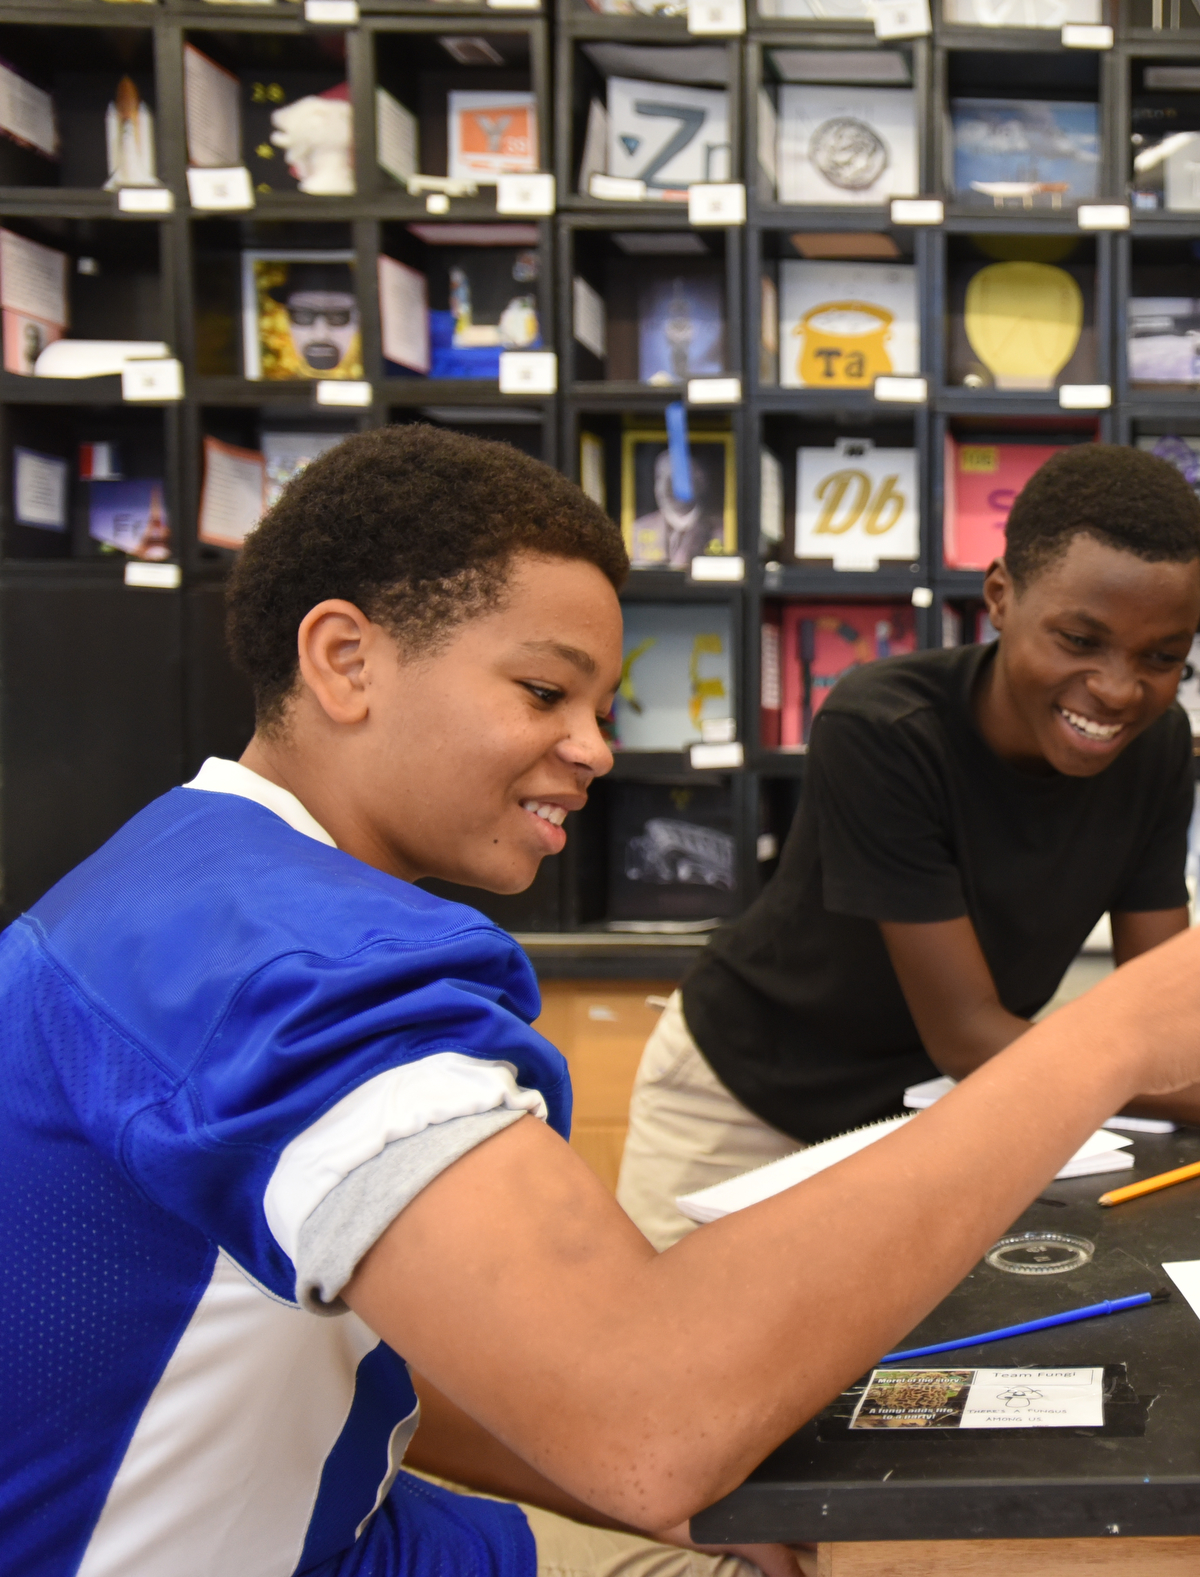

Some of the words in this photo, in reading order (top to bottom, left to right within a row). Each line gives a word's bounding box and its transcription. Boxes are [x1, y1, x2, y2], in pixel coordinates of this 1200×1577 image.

[474, 114, 512, 152] Y
[814, 348, 866, 378] Ta
[811, 467, 906, 536] Db
